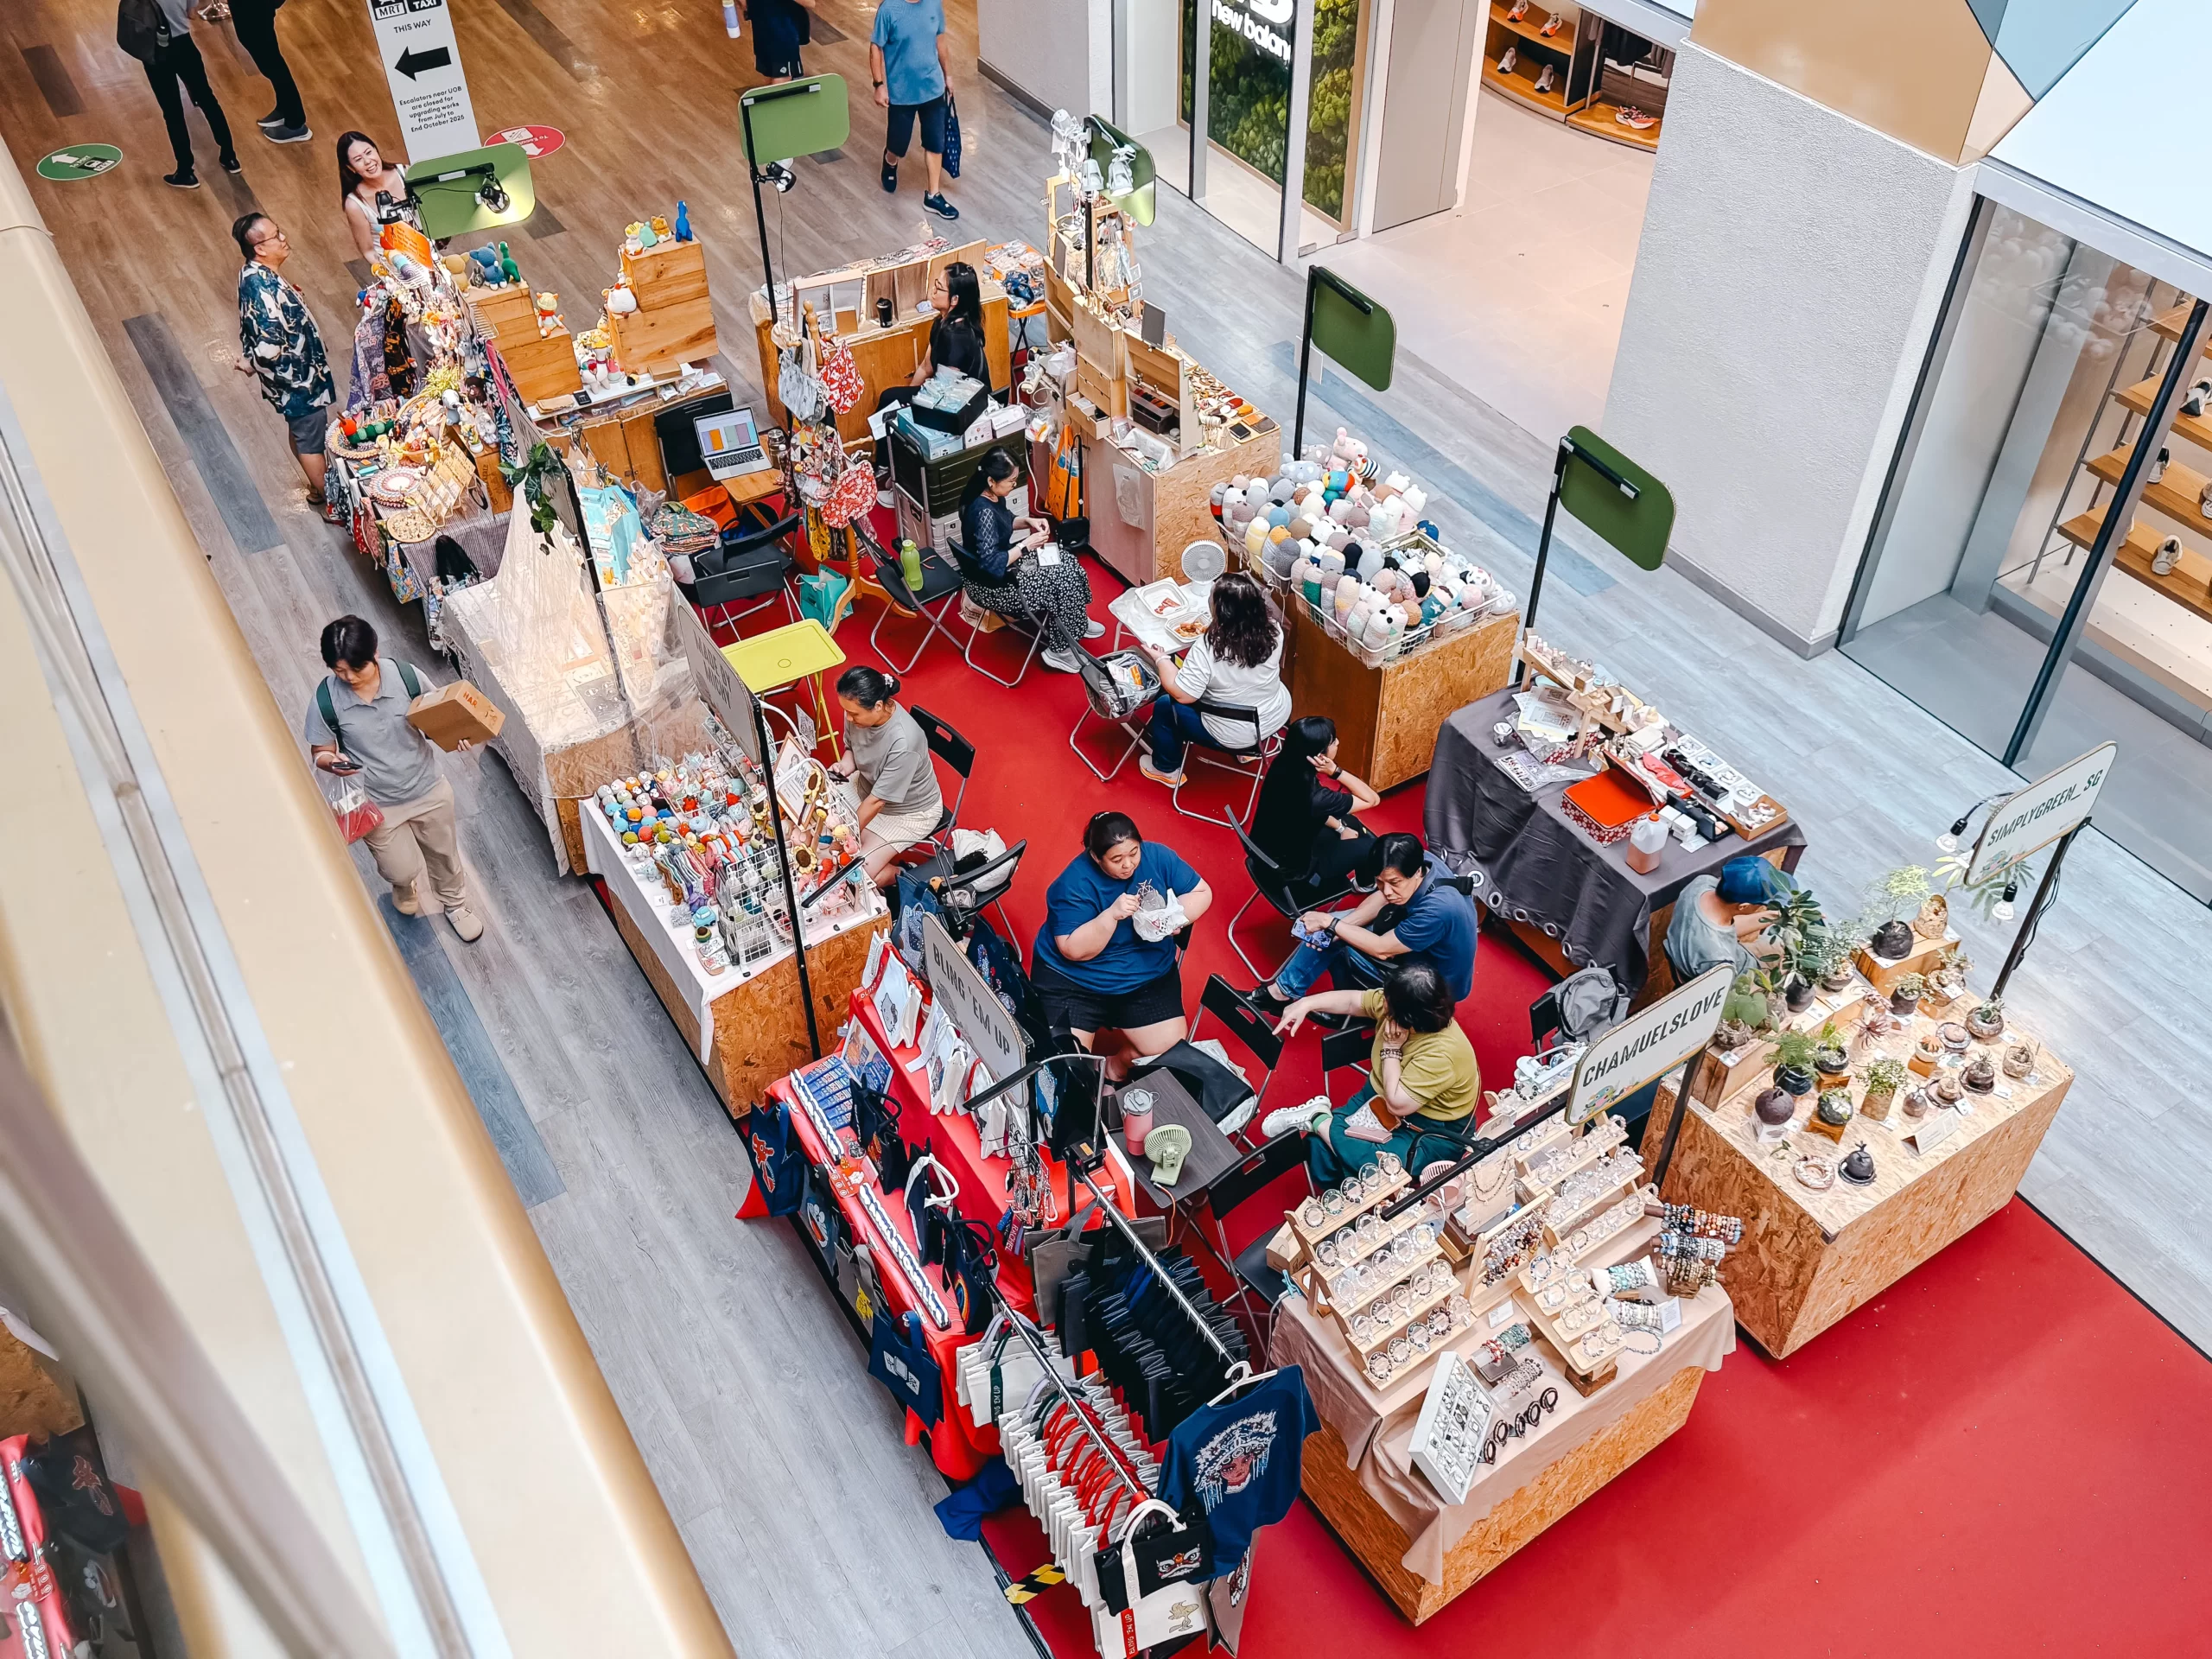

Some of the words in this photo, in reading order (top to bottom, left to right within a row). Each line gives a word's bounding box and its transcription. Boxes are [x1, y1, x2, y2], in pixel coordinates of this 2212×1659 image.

[378, 3, 401, 17] MRT
[413, 0, 437, 10] TAXI
[393, 23, 412, 34] THIS
[413, 18, 432, 29] WAY
[1211, 0, 1243, 32] new
[1243, 12, 1292, 64] balan
[399, 94, 432, 106] Escalators
[448, 86, 462, 94] UOB
[423, 98, 444, 108] closed
[409, 106, 441, 118] upgrading
[410, 124, 423, 133] End
[423, 119, 448, 130] October
[449, 114, 465, 124] 2025
[932, 943, 966, 1001] BLING
[994, 1025, 1011, 1056] UP
[1582, 985, 1726, 1088] CHAMUELSLOVE
[1004, 1224, 1020, 1252] RACHEL
[993, 1384, 1001, 1395] UP
[1124, 1613, 1133, 1623] UP
